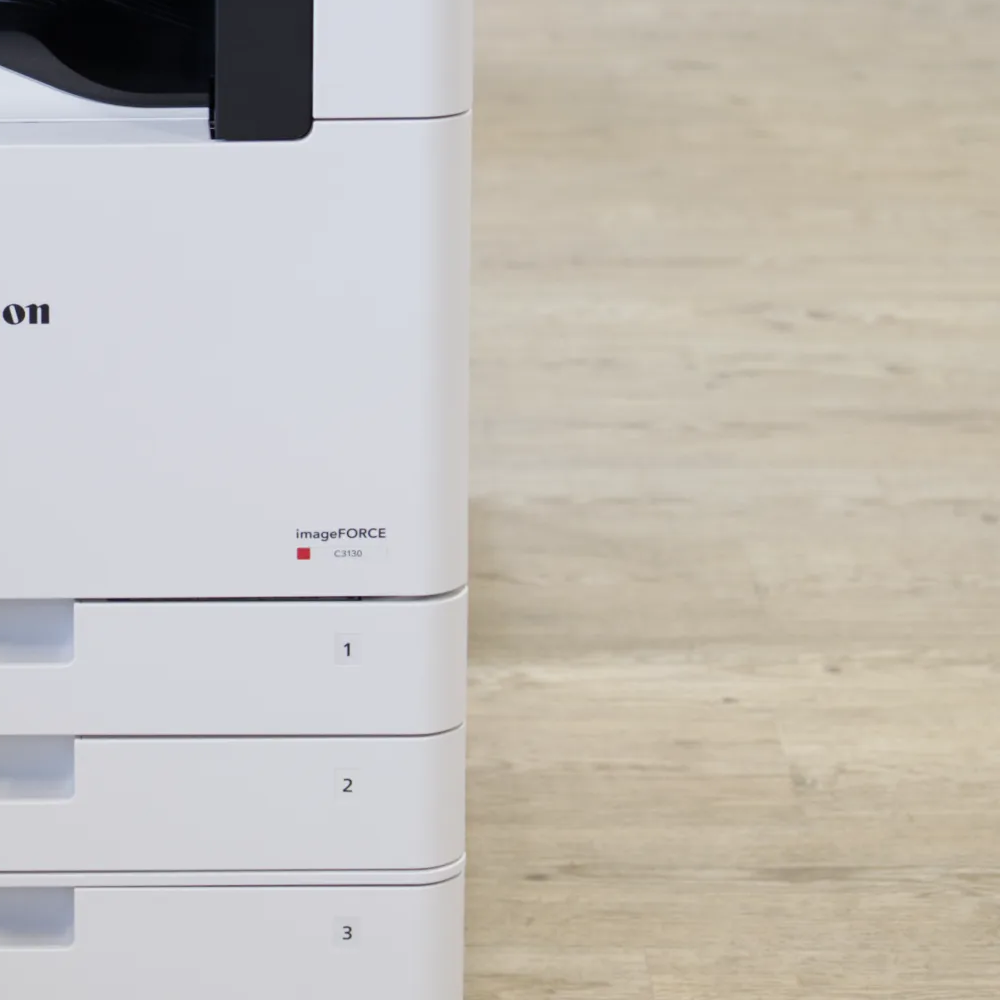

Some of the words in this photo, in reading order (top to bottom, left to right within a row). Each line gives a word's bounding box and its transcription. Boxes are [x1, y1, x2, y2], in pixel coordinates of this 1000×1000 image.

[296, 527, 386, 542] imageFORCE
[333, 549, 363, 558] C3130
[343, 642, 351, 657] 1
[342, 778, 353, 793] 2
[342, 925, 353, 941] 3
